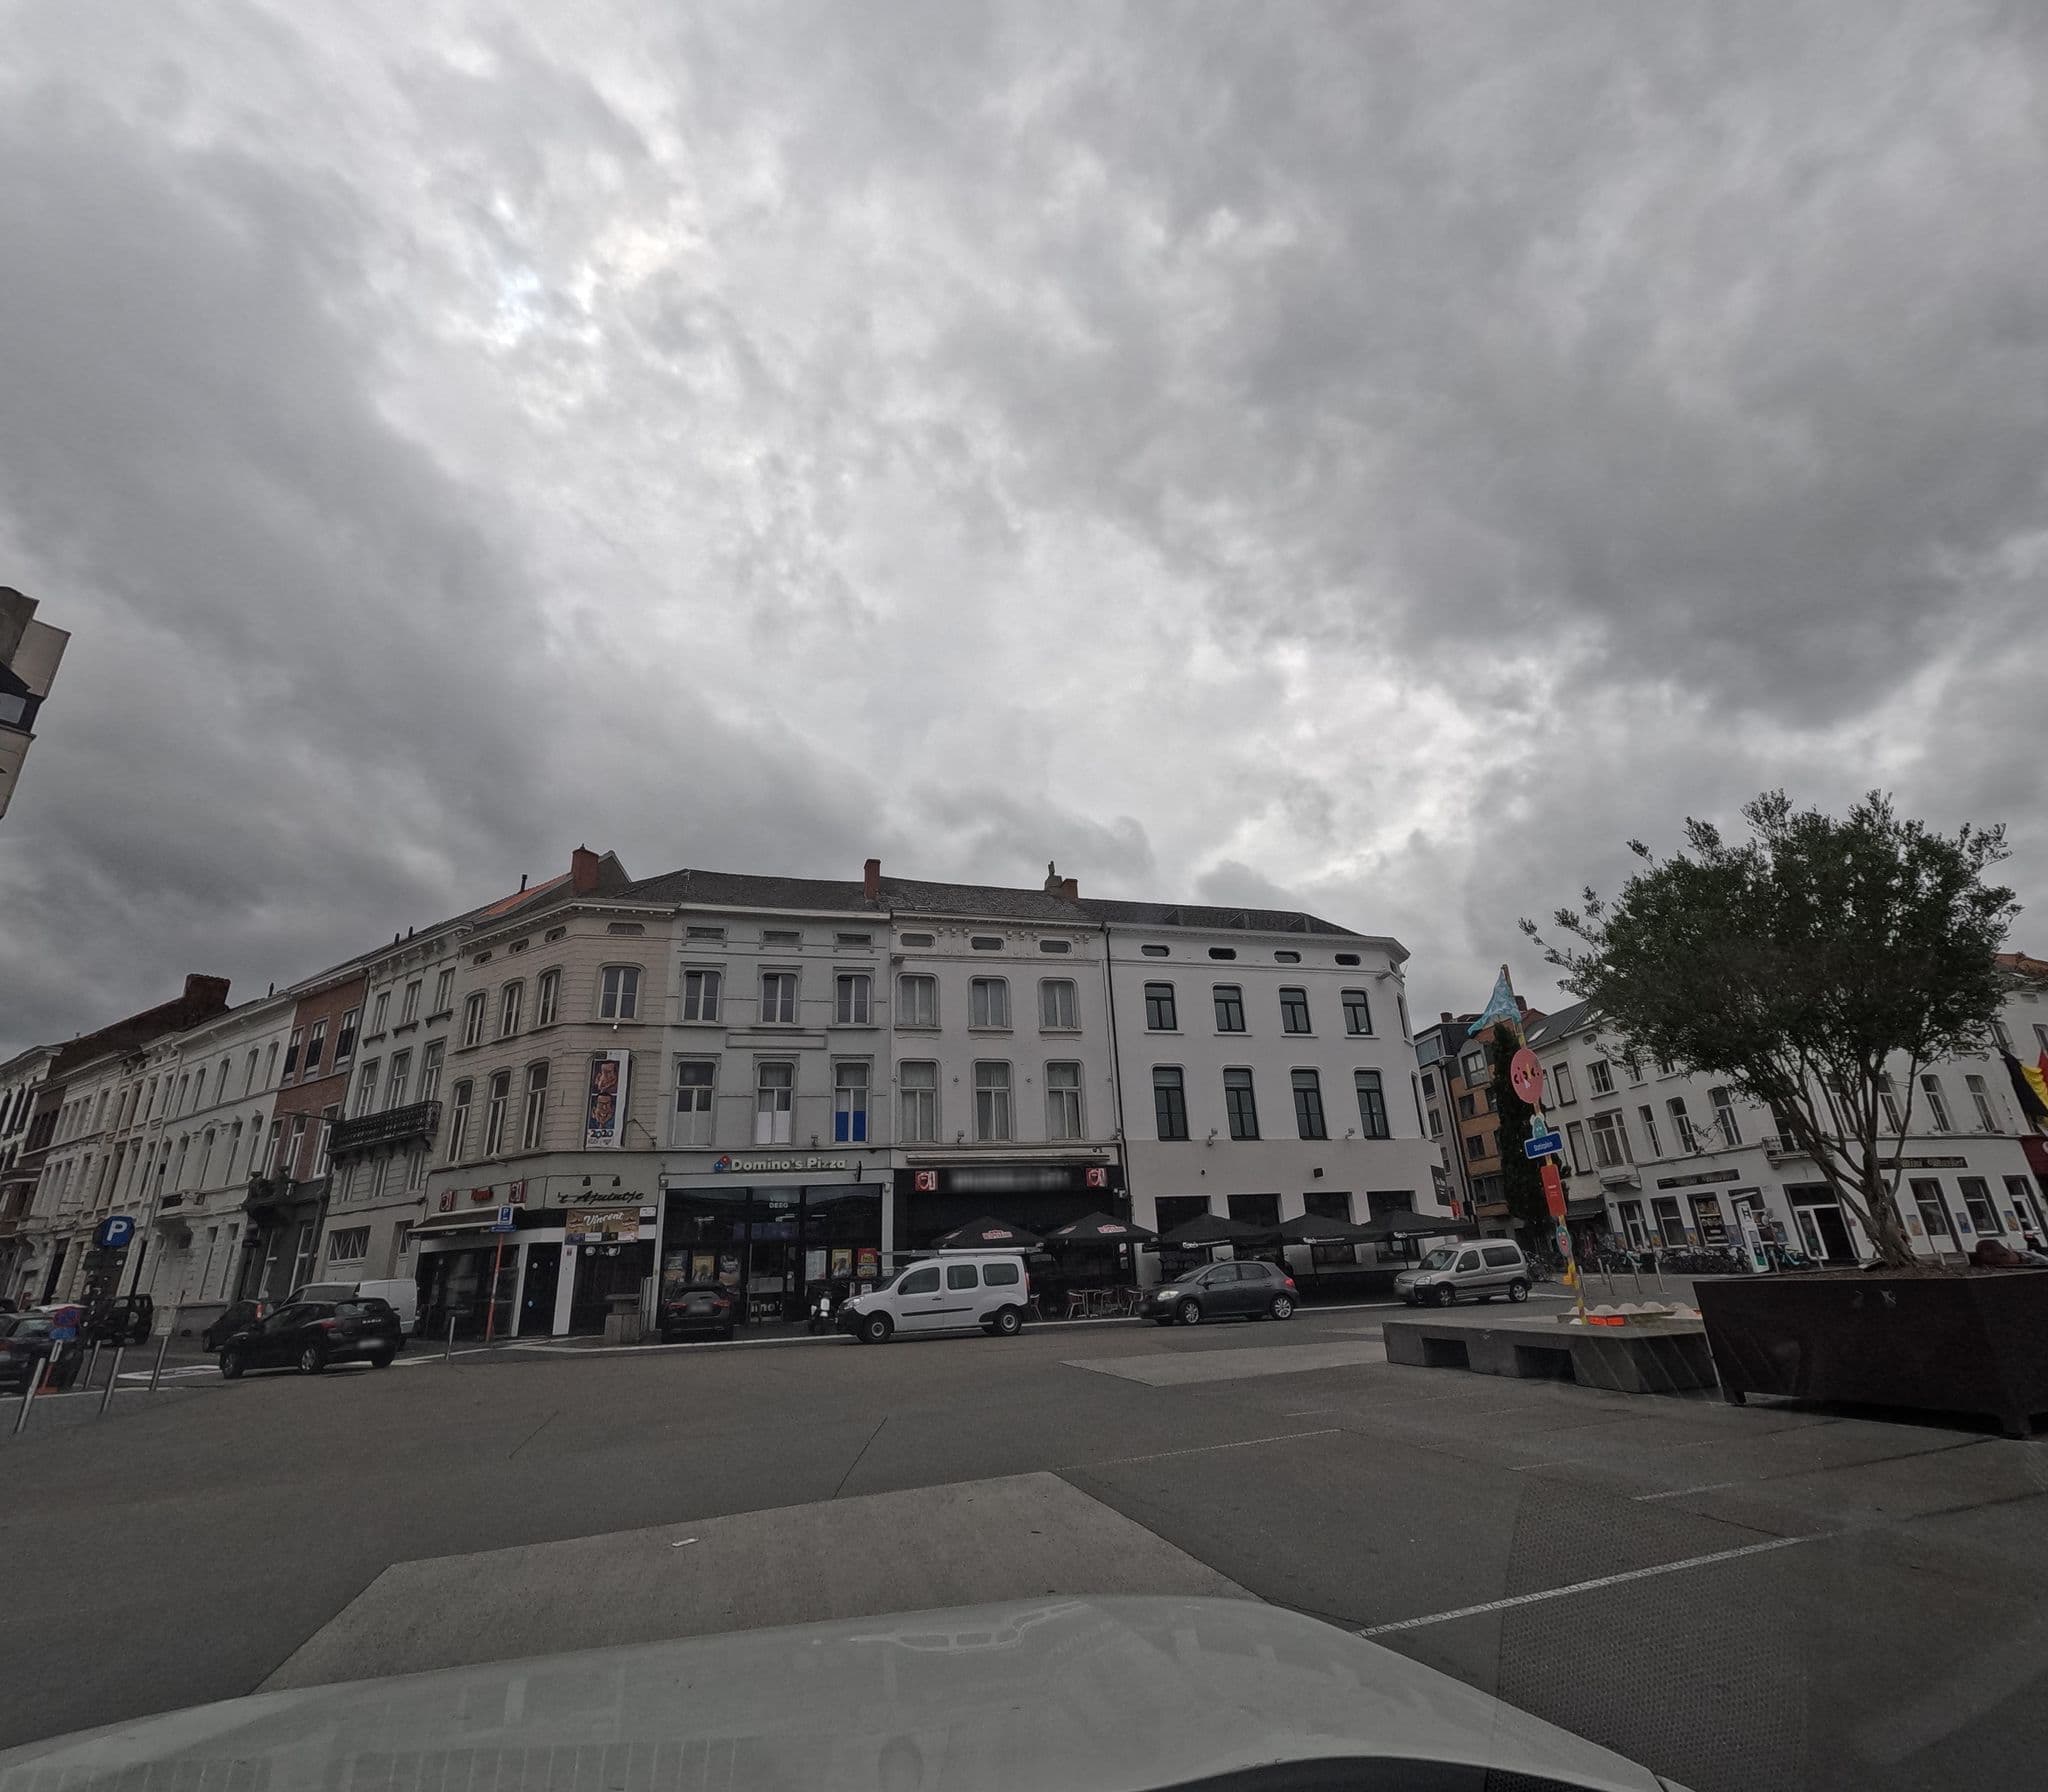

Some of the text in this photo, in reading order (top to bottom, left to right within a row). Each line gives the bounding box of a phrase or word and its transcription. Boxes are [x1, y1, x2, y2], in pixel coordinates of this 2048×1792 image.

[590, 1129, 614, 1138] 2020
[731, 1156, 847, 1171] Domino's Pizza
[583, 1212, 625, 1226] Vincent
[106, 1220, 128, 1241] P
